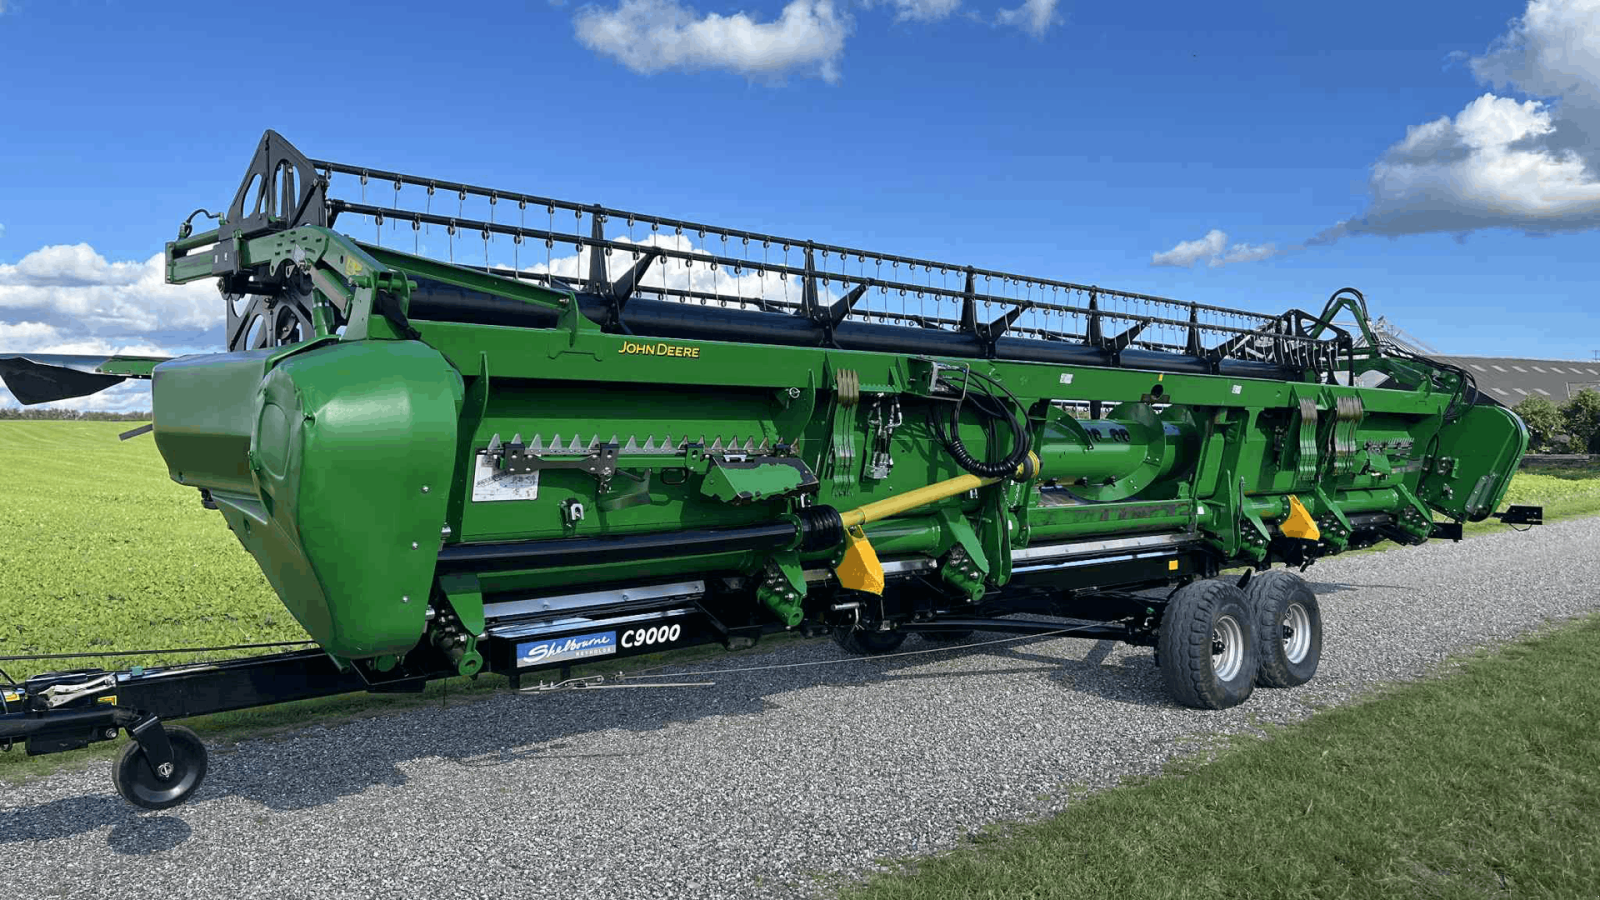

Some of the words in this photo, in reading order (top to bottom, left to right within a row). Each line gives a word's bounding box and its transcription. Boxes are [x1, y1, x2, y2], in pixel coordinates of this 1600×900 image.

[618, 341, 655, 355] JOHN
[656, 343, 700, 358] DEERE
[621, 624, 681, 648] C9000
[523, 636, 610, 663] Shelbourne
